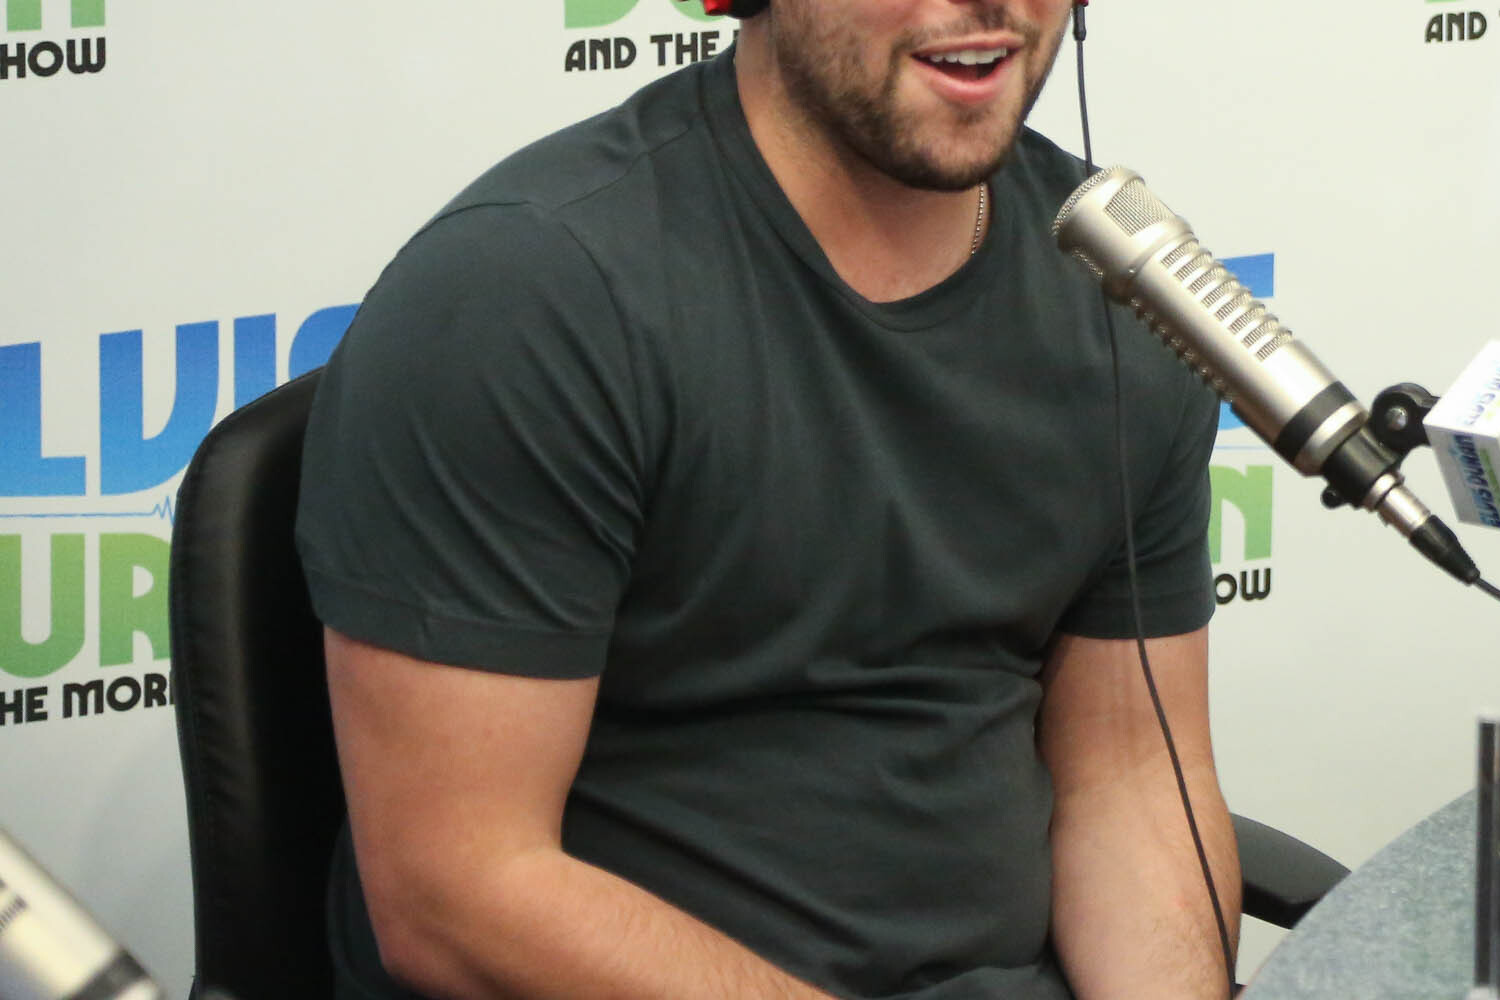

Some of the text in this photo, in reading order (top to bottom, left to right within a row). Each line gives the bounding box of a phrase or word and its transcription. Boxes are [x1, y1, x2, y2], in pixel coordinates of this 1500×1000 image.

[1424, 11, 1487, 43] AND
[0, 37, 106, 79] HOW
[565, 31, 719, 72] AND THE
[0, 686, 48, 726] HE
